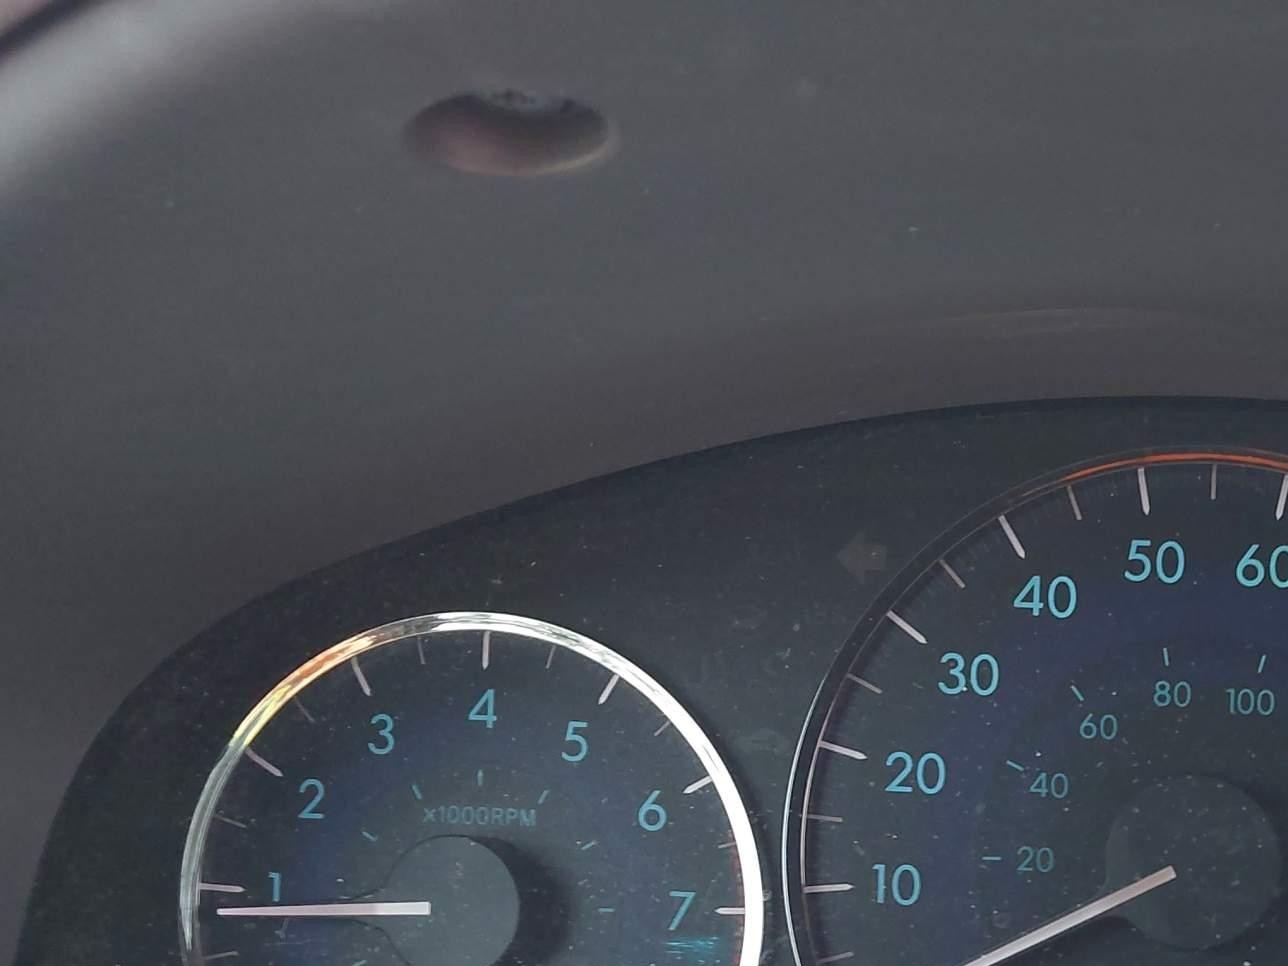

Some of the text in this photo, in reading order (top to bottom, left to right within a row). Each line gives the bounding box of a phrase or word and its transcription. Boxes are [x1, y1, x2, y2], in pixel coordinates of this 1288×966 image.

[1124, 540, 1185, 584] 50
[1014, 576, 1077, 619] 40
[938, 653, 999, 696] 30
[1153, 680, 1191, 708] 80
[468, 688, 498, 729] 4
[1226, 689, 1275, 716] 100
[367, 714, 395, 754] 3
[561, 720, 589, 762] 5
[1079, 713, 1118, 740] 60
[884, 751, 946, 795] 20
[1029, 773, 1069, 799] 40
[298, 779, 325, 820] 2
[638, 790, 666, 831] 6
[1016, 846, 1054, 873] 20
[267, 872, 283, 902] 1
[873, 863, 922, 906] 10
[668, 890, 696, 931] 7
